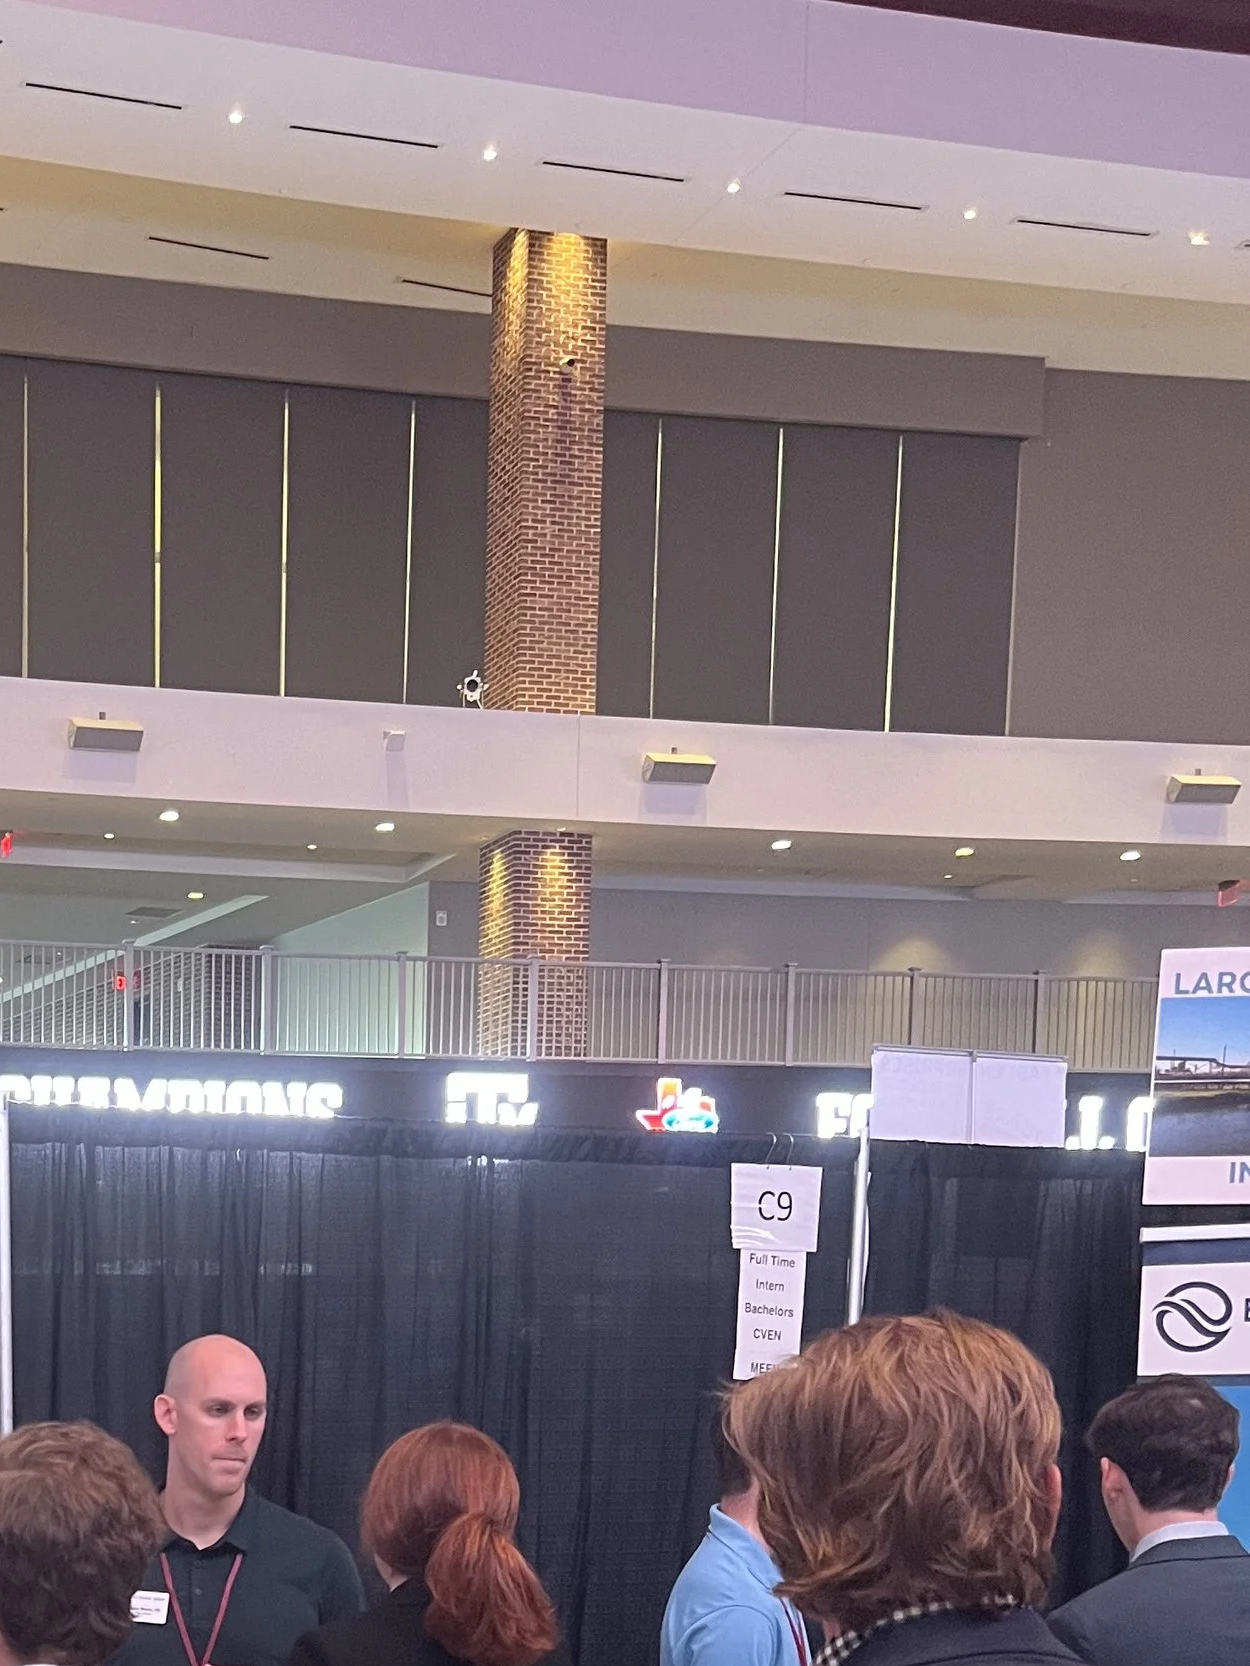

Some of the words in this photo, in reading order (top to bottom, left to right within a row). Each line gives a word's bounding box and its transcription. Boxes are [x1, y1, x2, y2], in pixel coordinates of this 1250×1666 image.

[758, 1191, 793, 1221] C9
[750, 1253, 768, 1266] Full
[771, 1256, 795, 1268] Time
[756, 1279, 784, 1292] Intern
[745, 1303, 794, 1318] Bachelors
[753, 1329, 781, 1341] CVEN
